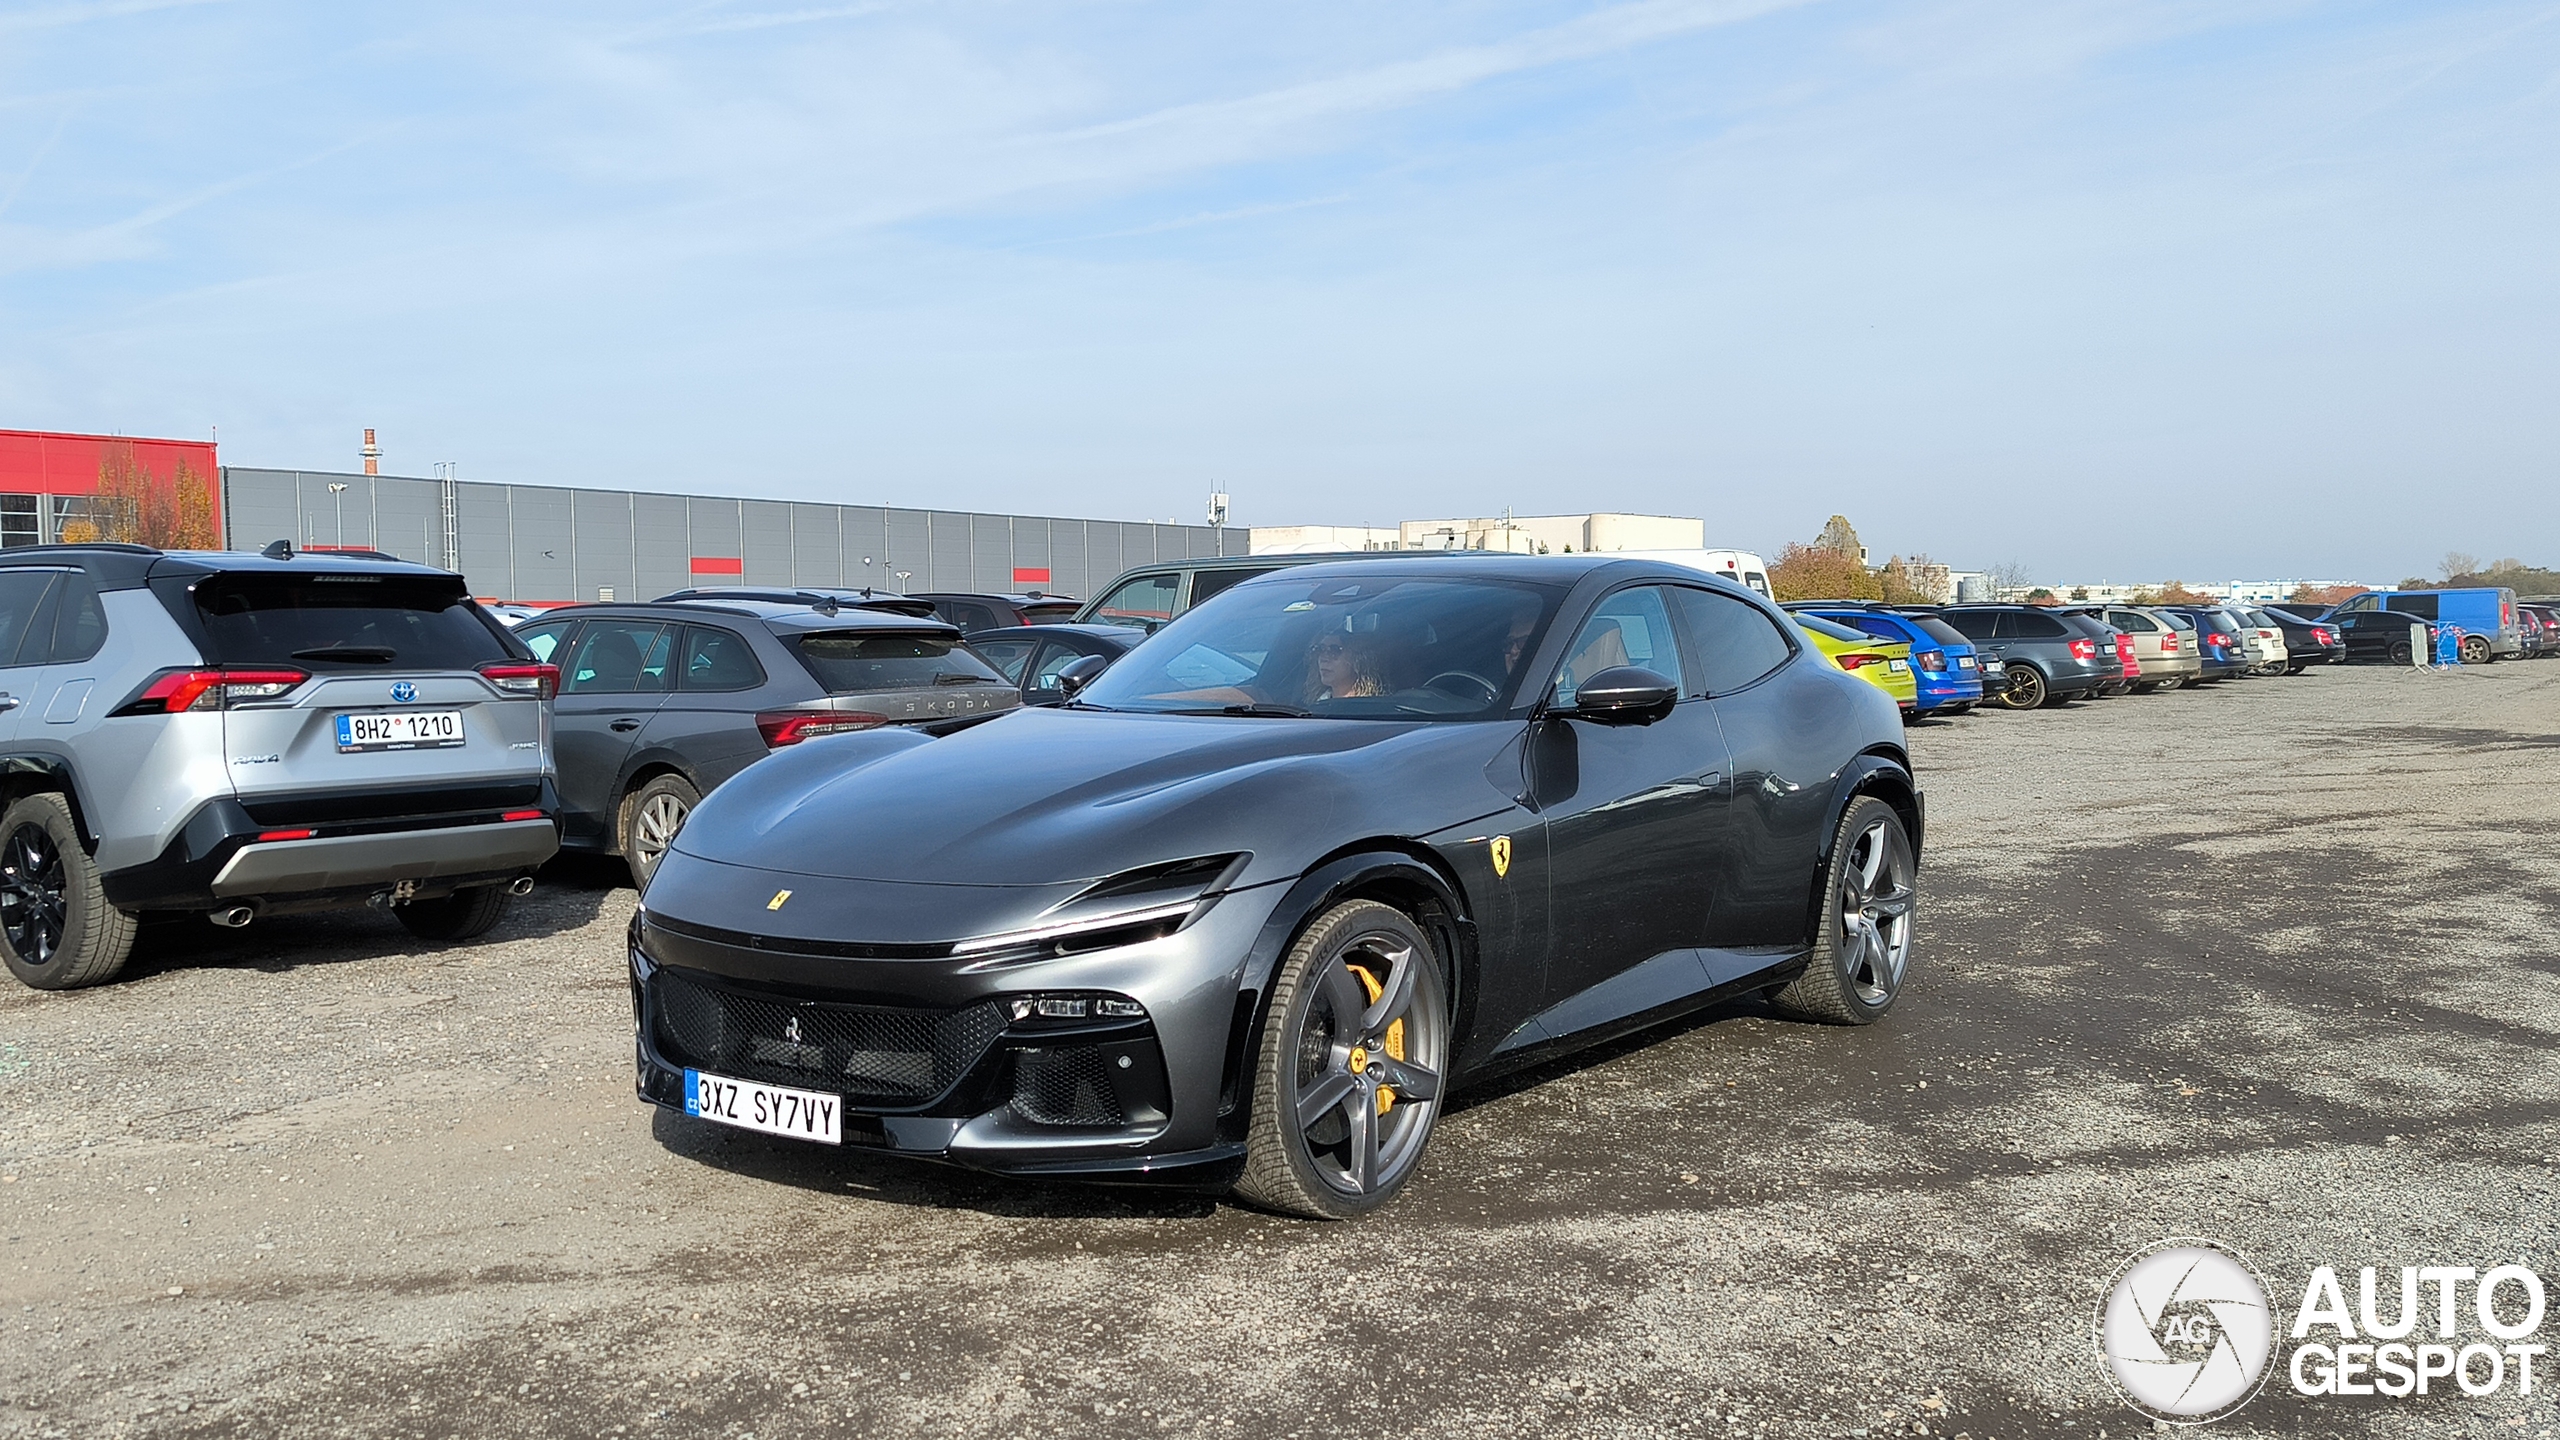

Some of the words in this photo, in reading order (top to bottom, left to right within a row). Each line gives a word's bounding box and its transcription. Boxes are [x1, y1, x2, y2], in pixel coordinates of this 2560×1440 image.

[340, 733, 350, 741] CZ
[355, 718, 392, 740] 8H2
[408, 716, 453, 737] 1210
[688, 1097, 698, 1110] CZ
[699, 1079, 739, 1119] 3XZ
[754, 1090, 833, 1135] SY7VY
